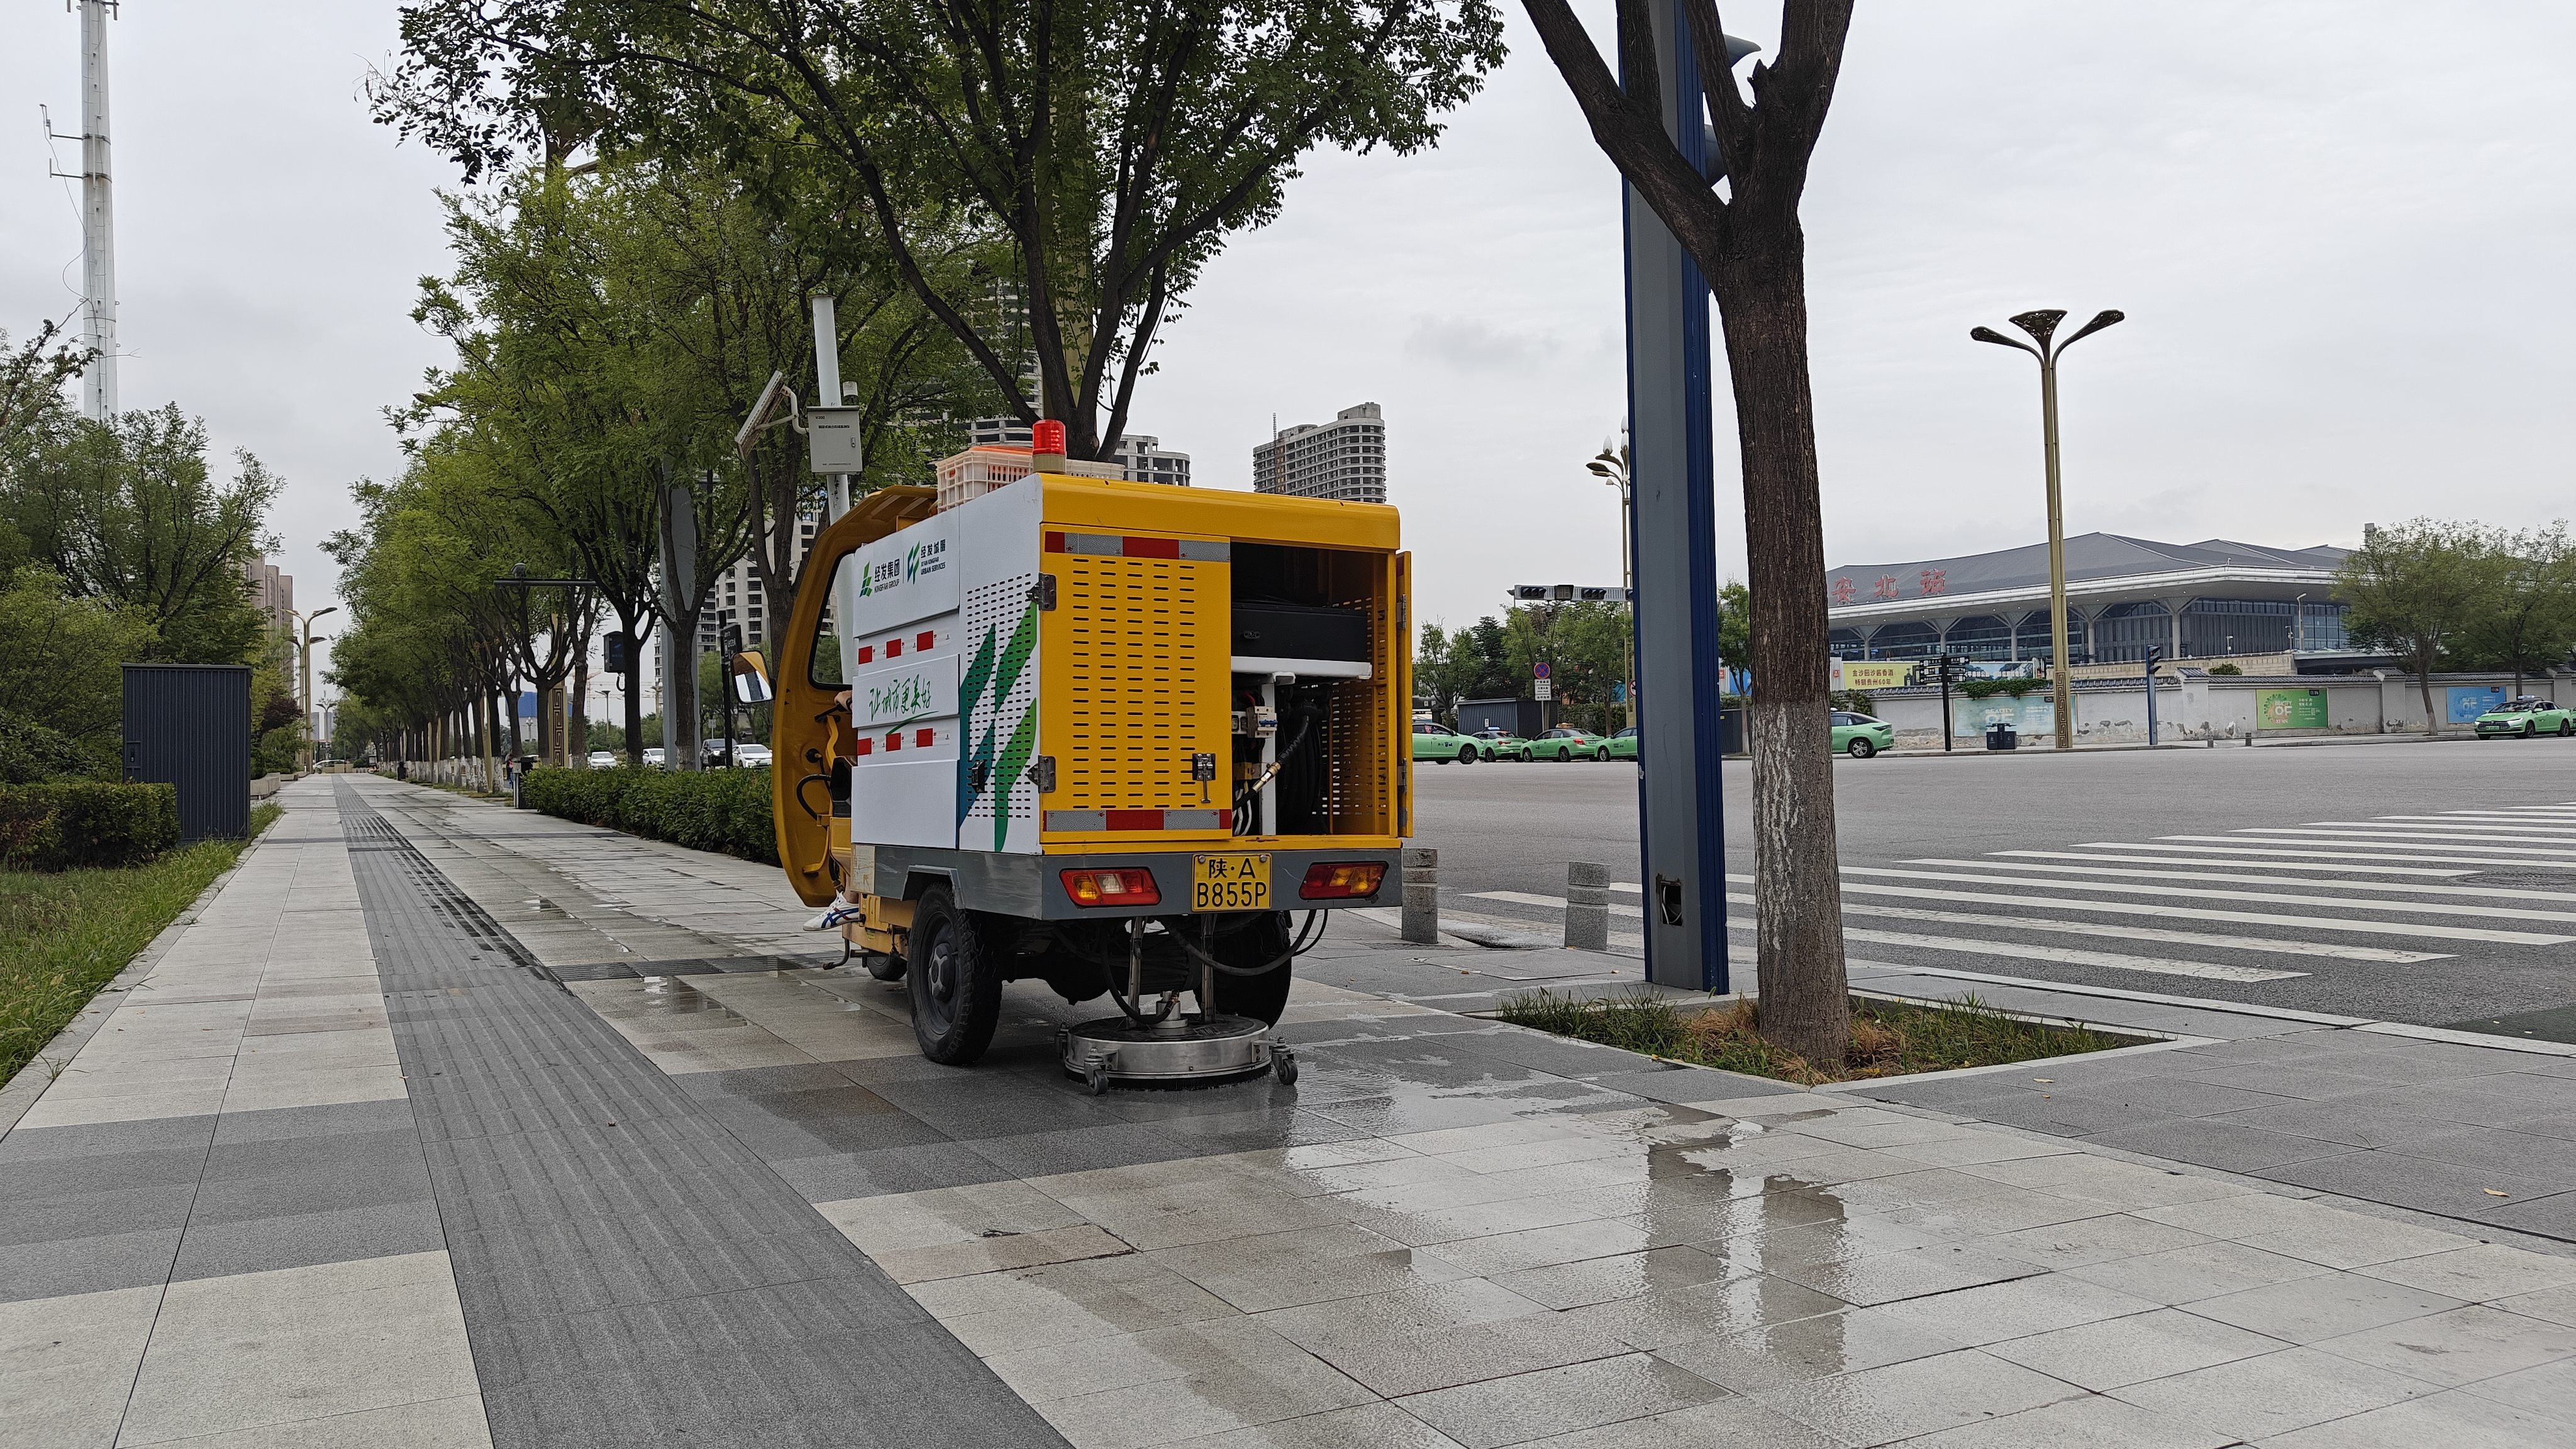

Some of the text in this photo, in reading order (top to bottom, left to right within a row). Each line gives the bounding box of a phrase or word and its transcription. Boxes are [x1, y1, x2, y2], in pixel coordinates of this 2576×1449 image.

[921, 539, 946, 558] 经发城服
[874, 558, 900, 582] 经发集团
[921, 562, 946, 575] URBAN SERVICES
[874, 579, 900, 593] KINGFAR GROUP
[1852, 669, 1894, 677] 金沙回沙酱香酒
[869, 674, 931, 721] 让城市更美好
[2275, 706, 2292, 716] OF
[1209, 858, 1256, 879] 陕·A
[1197, 882, 1267, 908] B855P
